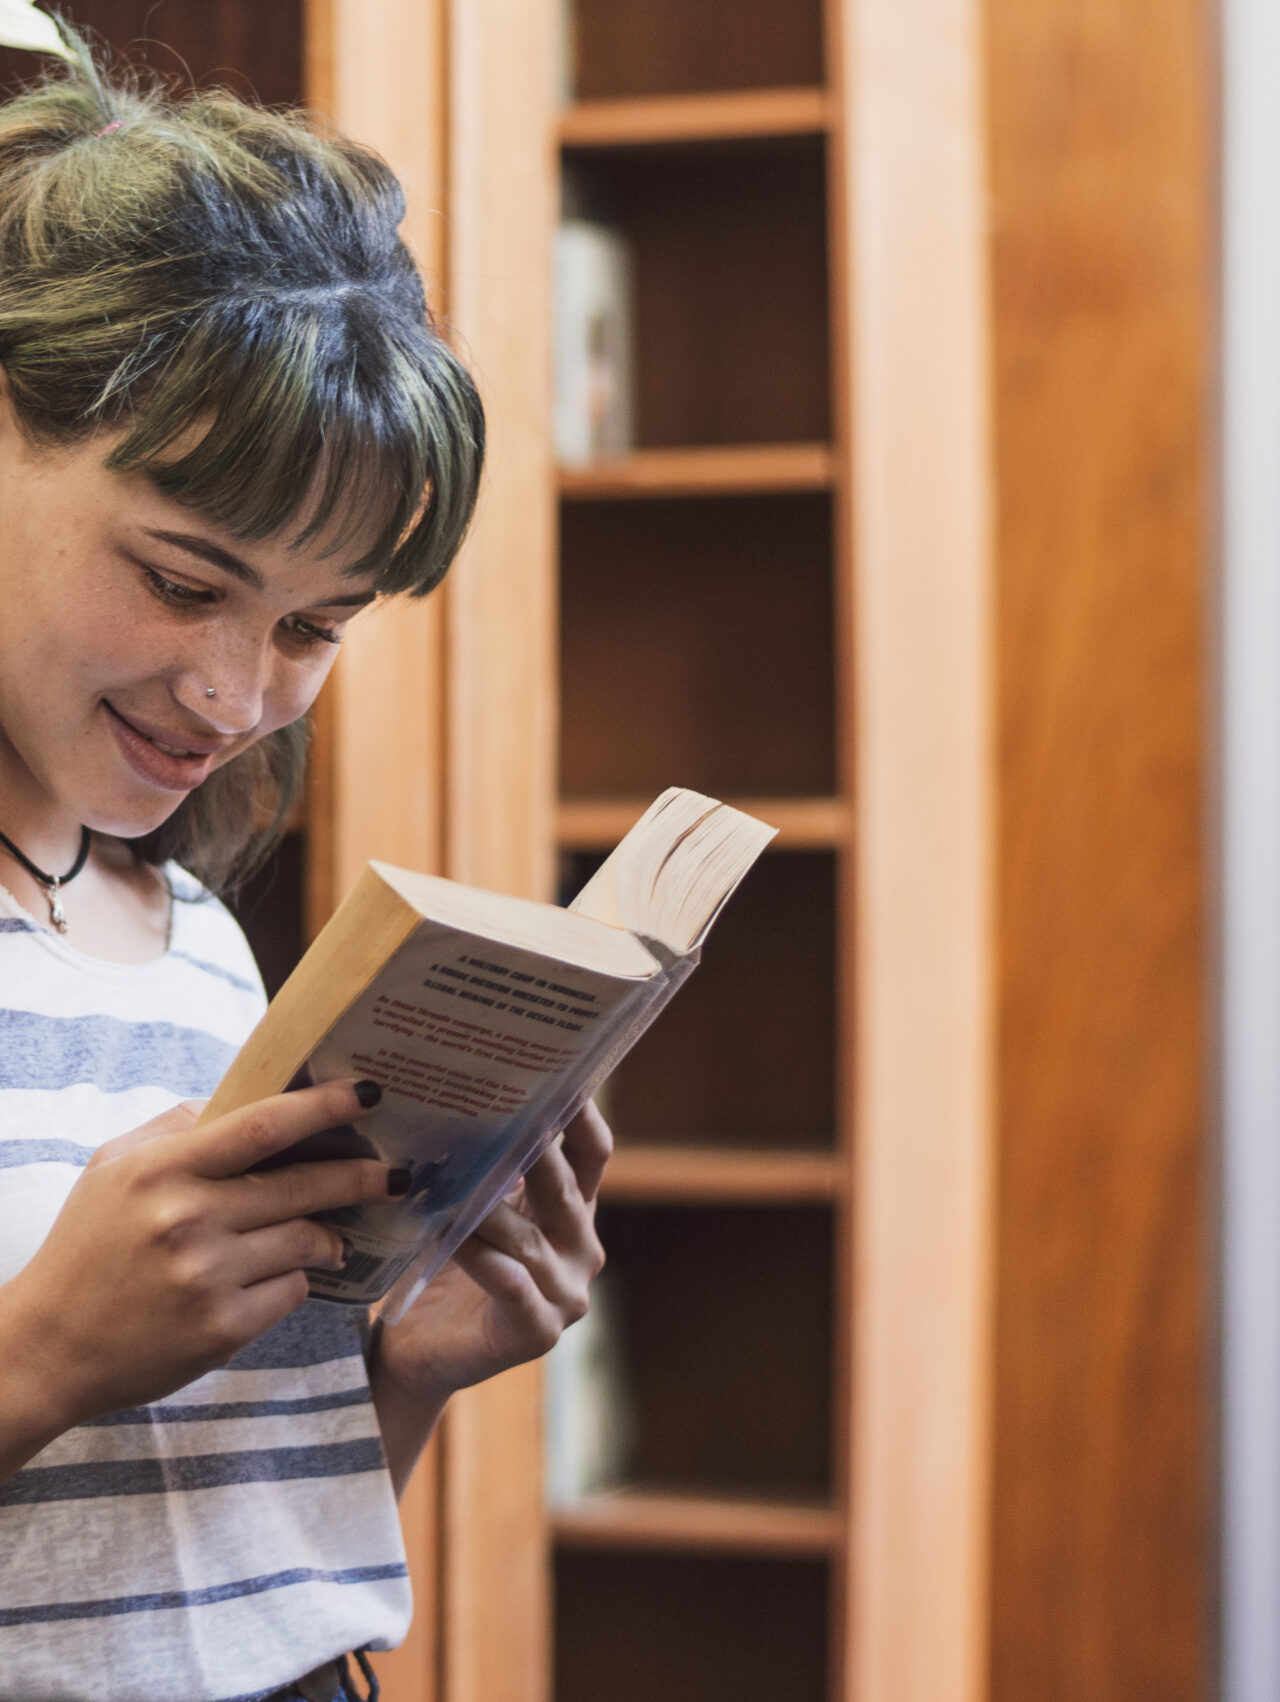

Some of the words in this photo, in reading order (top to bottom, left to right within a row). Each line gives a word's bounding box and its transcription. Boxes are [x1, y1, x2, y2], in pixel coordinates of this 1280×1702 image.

[468, 958, 509, 975] MILITARY
[510, 971, 535, 983] COUP
[535, 978, 548, 987] IN
[424, 979, 456, 995] ILLEGAL
[458, 990, 495, 1006] MINING
[509, 1006, 525, 1015] THE
[526, 1011, 556, 1024] OCEAN
[439, 966, 468, 980] ROGUE
[470, 976, 511, 993] DICTATOR
[512, 989, 555, 1007] ROCKETED
[556, 1003, 569, 1011] TO
[378, 995, 389, 1003] As
[391, 1000, 416, 1012] these
[418, 1008, 451, 1022] threads
[503, 1035, 528, 1047] young
[383, 1011, 425, 1026] recruited
[389, 1052, 405, 1061] this
[424, 1034, 439, 1043] the
[474, 1048, 494, 1059] first
[398, 1068, 425, 1077] action
[427, 1075, 444, 1083] and
[443, 1080, 497, 1101] breathtaking
[402, 1080, 430, 1090] create
